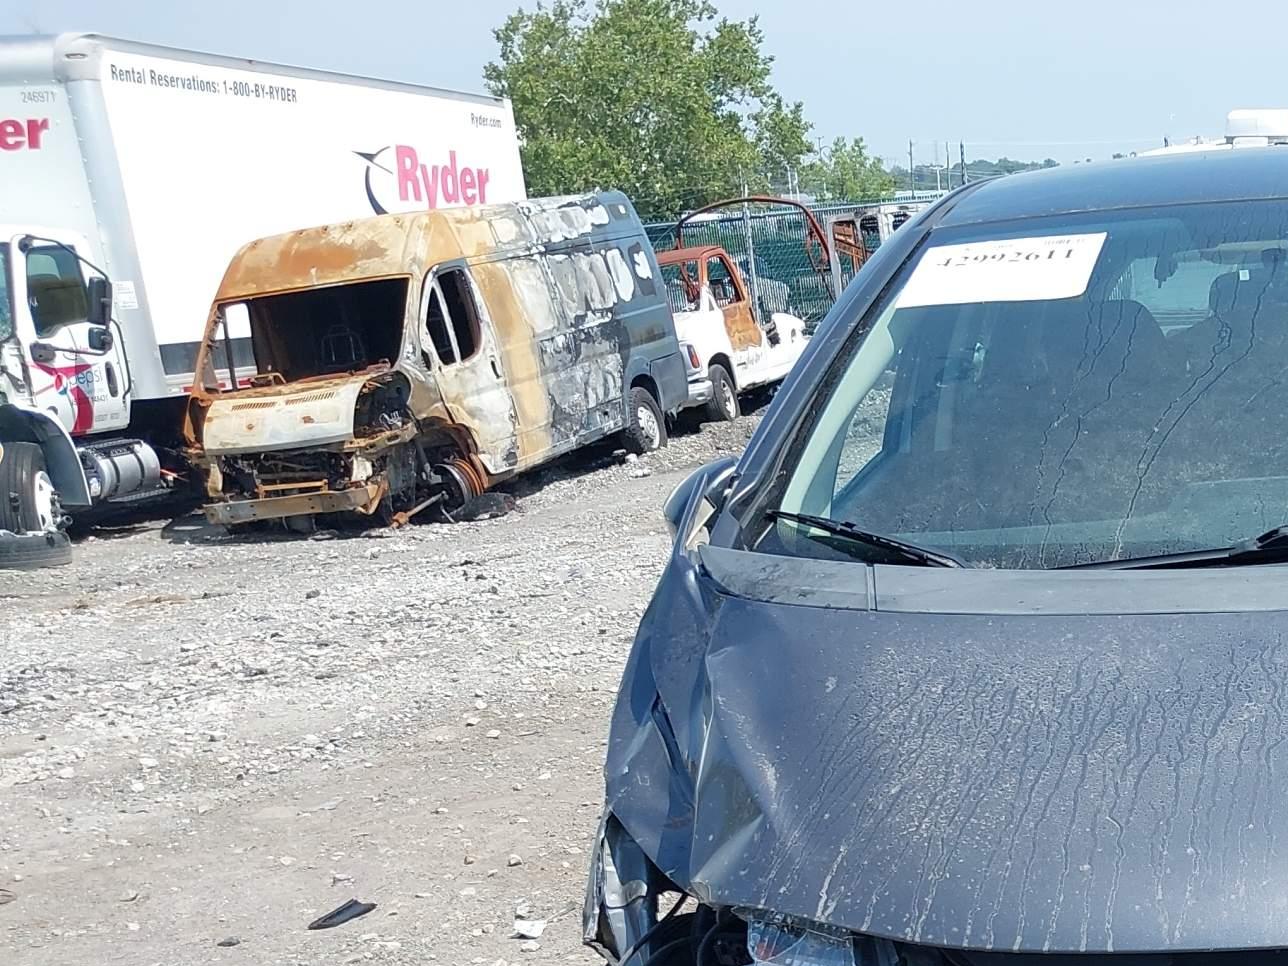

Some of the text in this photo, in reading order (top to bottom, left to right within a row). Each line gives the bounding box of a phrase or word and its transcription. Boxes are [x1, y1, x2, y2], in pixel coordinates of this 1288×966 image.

[110, 63, 298, 103] Rental Reservations: 1-800-BY-RYDER
[470, 112, 502, 129] Ryder.com
[395, 144, 490, 210] Ryder
[937, 249, 1073, 267] 42992611
